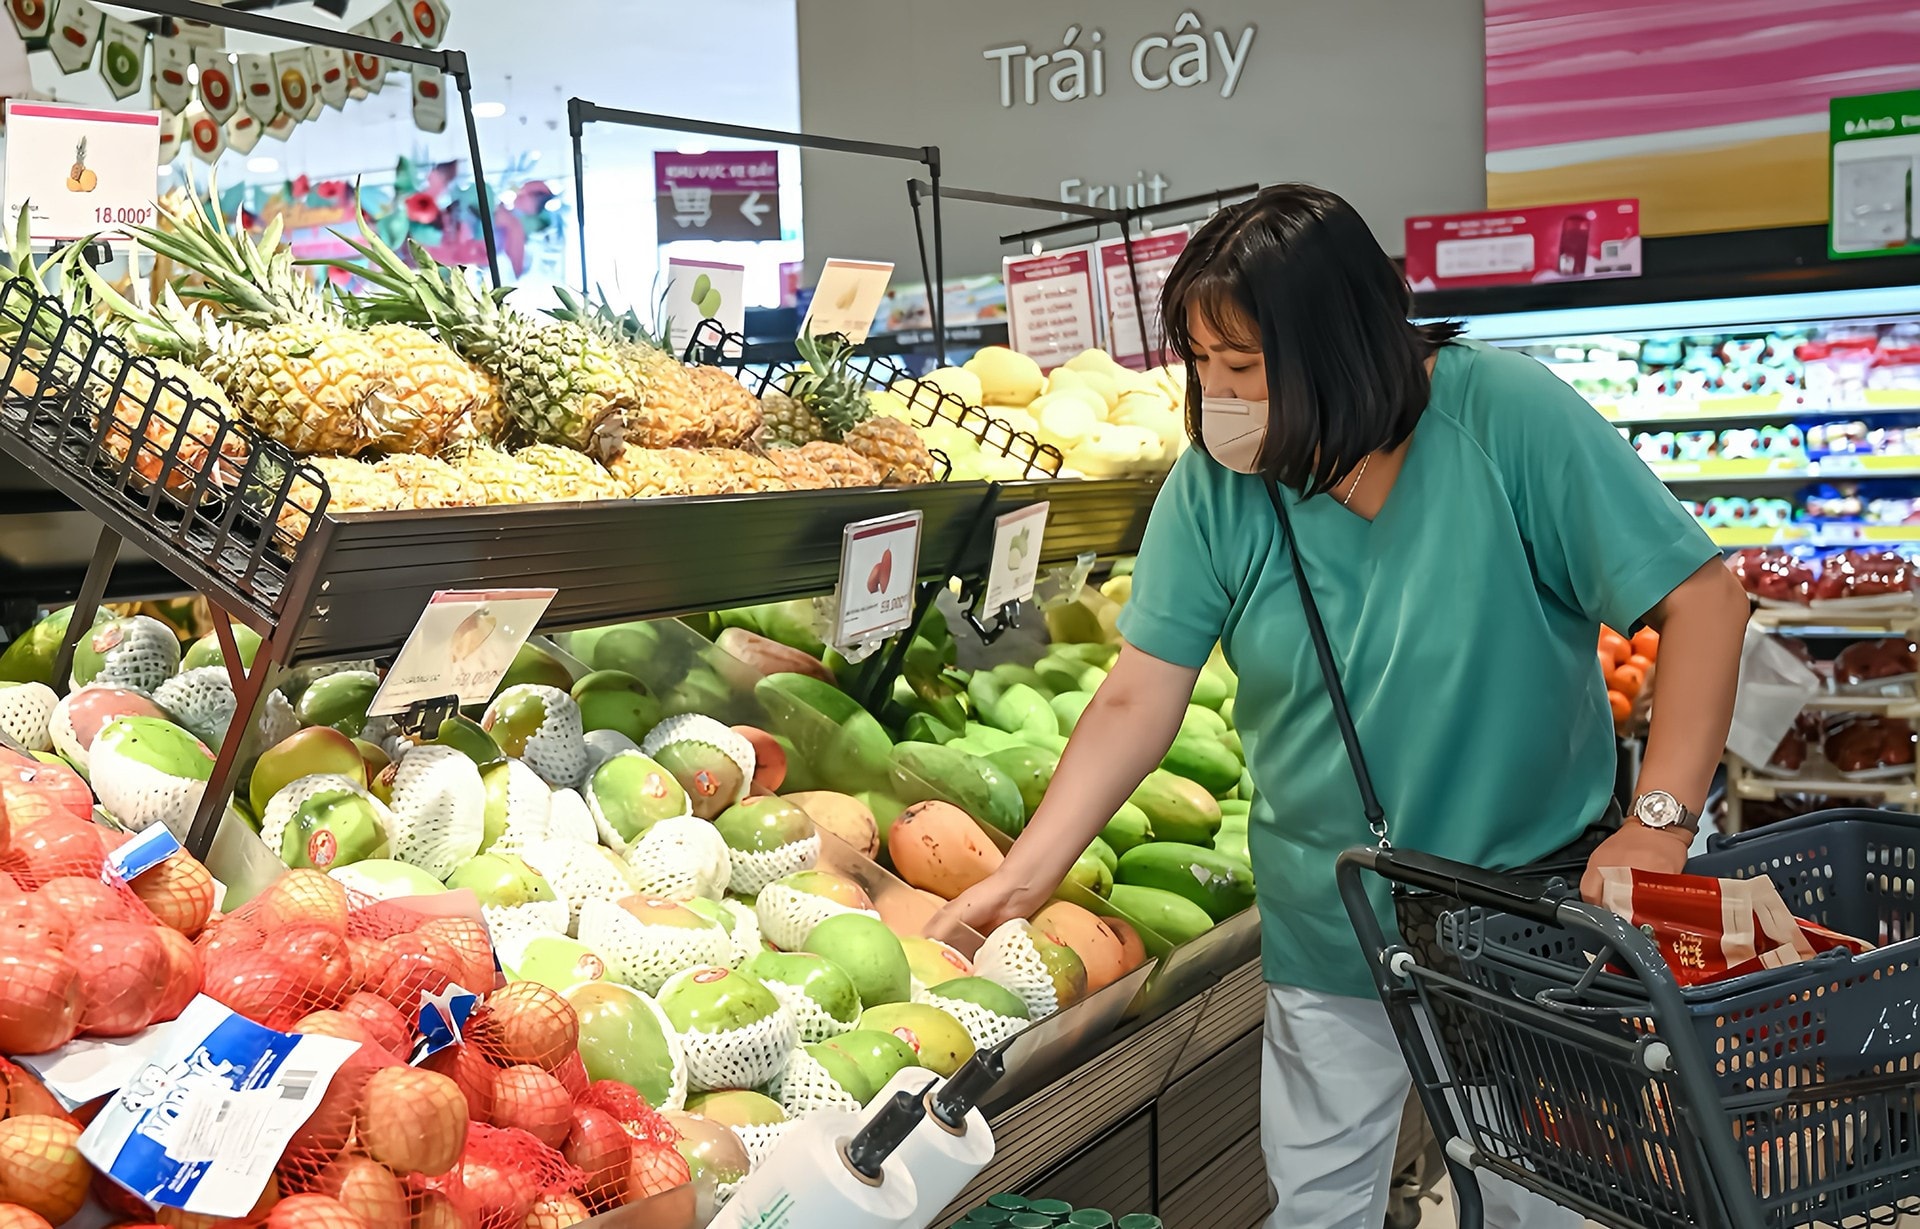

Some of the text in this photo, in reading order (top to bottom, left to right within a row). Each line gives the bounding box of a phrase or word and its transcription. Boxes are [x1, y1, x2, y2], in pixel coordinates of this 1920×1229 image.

[982, 10, 1257, 108] Trái cây
[1060, 170, 1168, 221] Fruit
